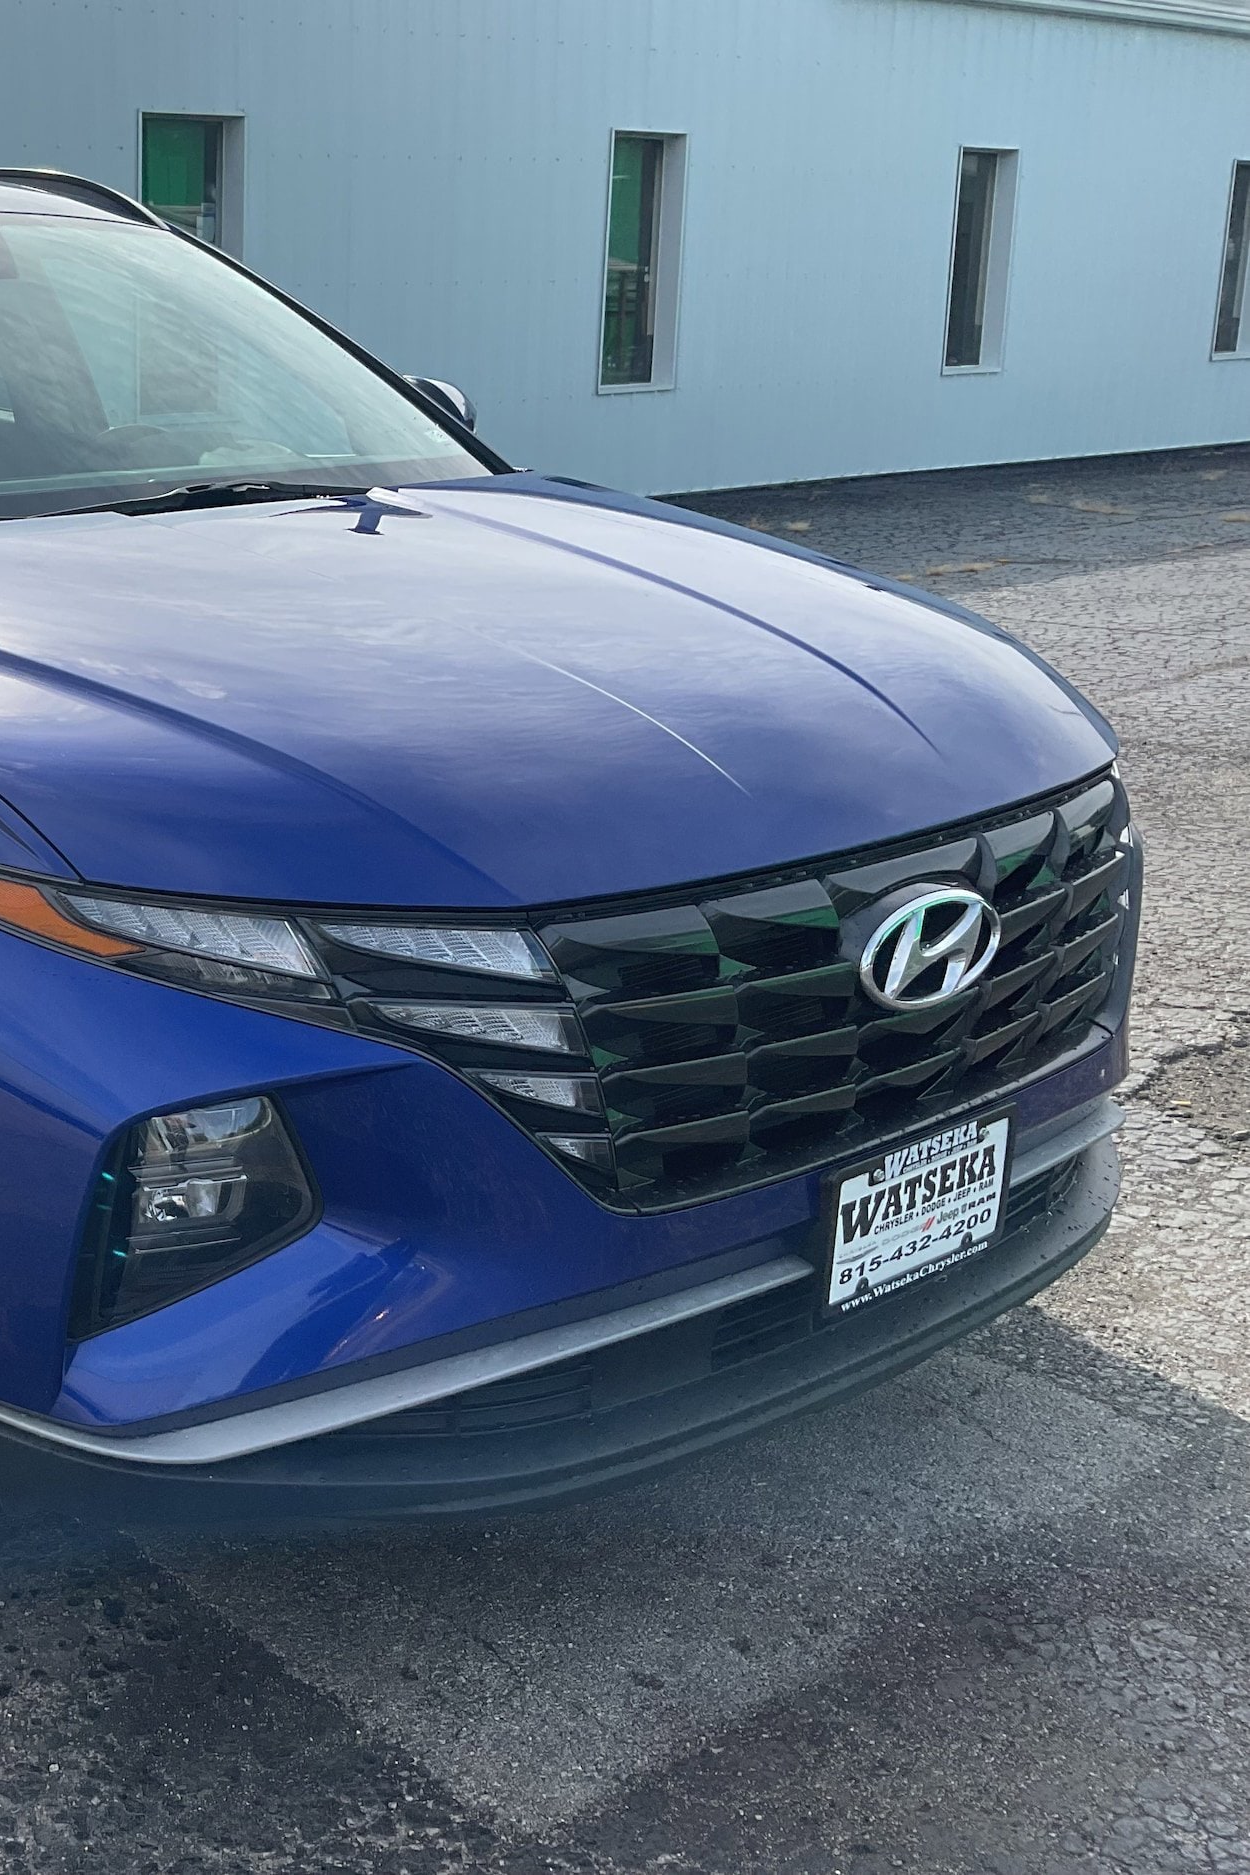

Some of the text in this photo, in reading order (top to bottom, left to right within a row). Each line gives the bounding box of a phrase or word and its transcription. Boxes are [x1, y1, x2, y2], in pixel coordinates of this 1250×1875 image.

[884, 1120, 978, 1181] WATSEKA
[840, 1143, 996, 1246] WATSEKA
[873, 1177, 994, 1235] CHRYSLER DODGE JEEP RAM
[937, 1208, 960, 1225] Jeep
[968, 1191, 996, 1210] RAM
[839, 1207, 992, 1285] 815-432-4200
